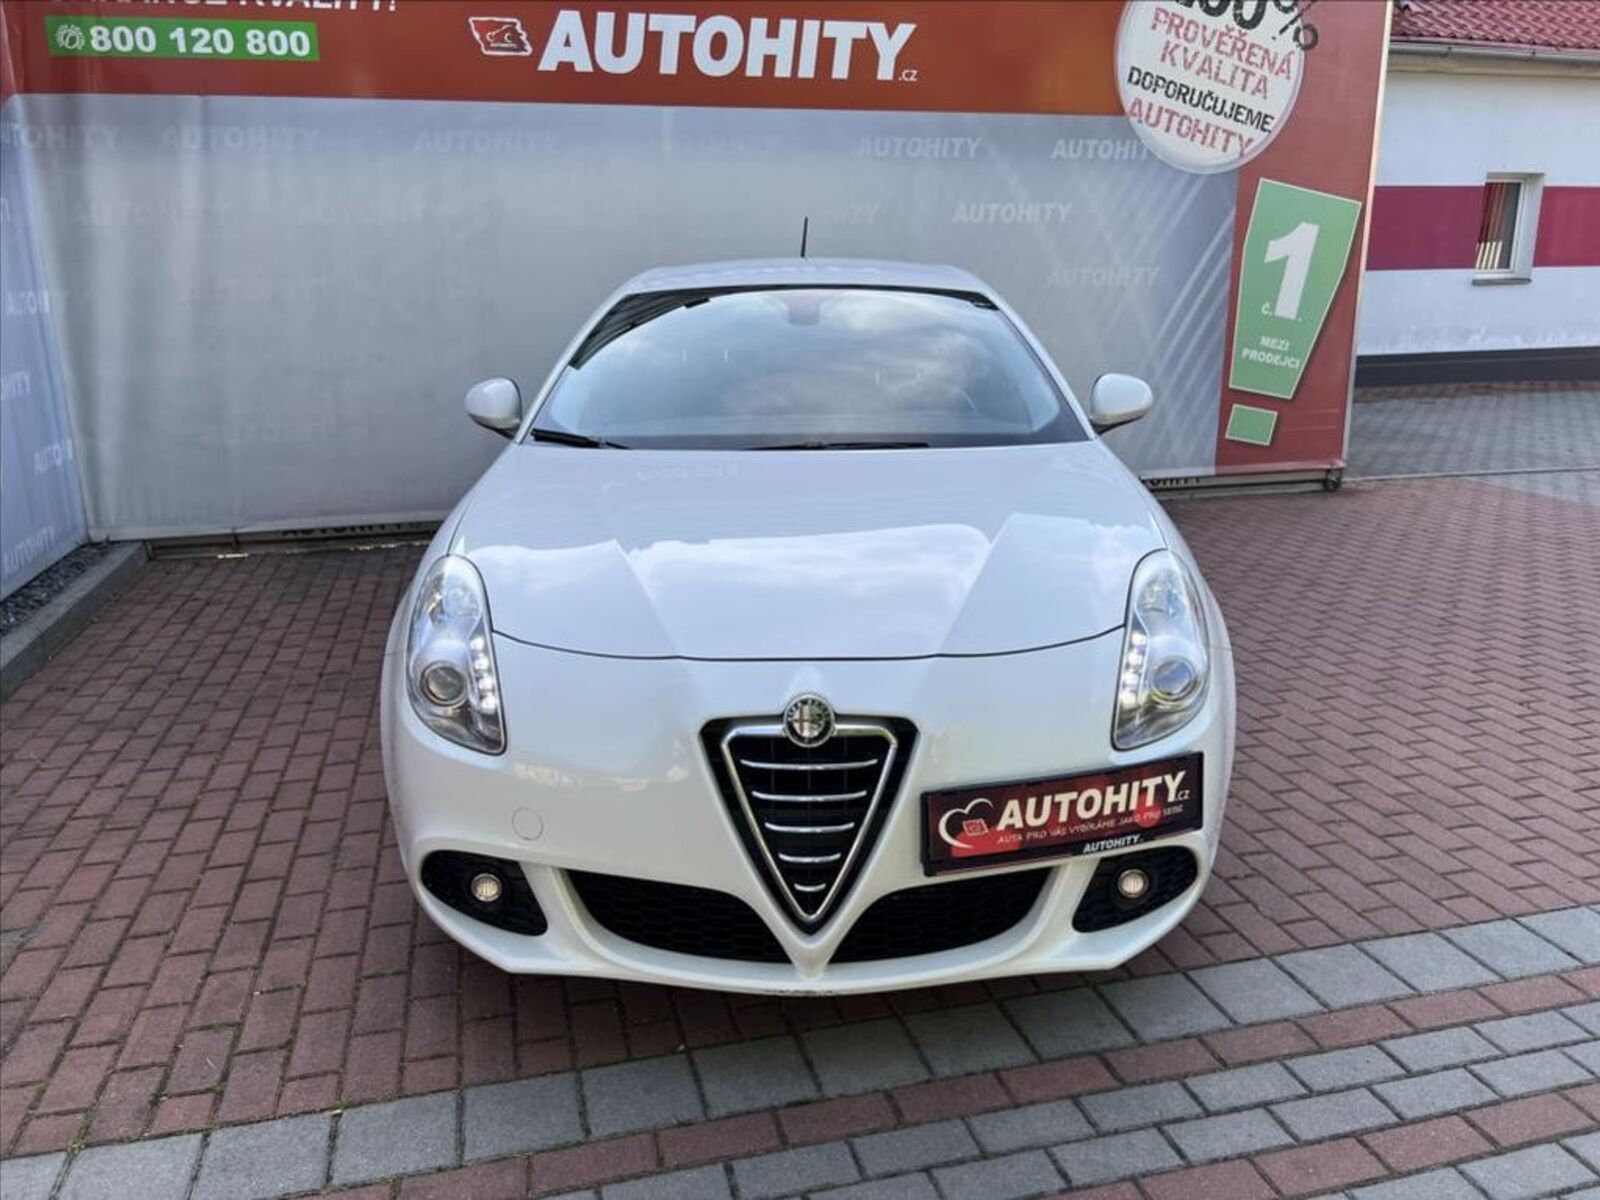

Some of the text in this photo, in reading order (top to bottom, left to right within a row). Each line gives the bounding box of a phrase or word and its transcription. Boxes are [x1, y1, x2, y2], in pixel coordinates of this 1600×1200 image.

[89, 25, 311, 57] 800 120 800
[1151, 7, 1295, 80] PROVĚŘENÁ
[1160, 40, 1269, 100] KVALITA
[1127, 66, 1275, 133] DOPORUČUJEME
[1128, 97, 1254, 158] AUTOHITY
[857, 137, 982, 159] AUTOHITY
[952, 203, 1073, 224] AUTOHITY
